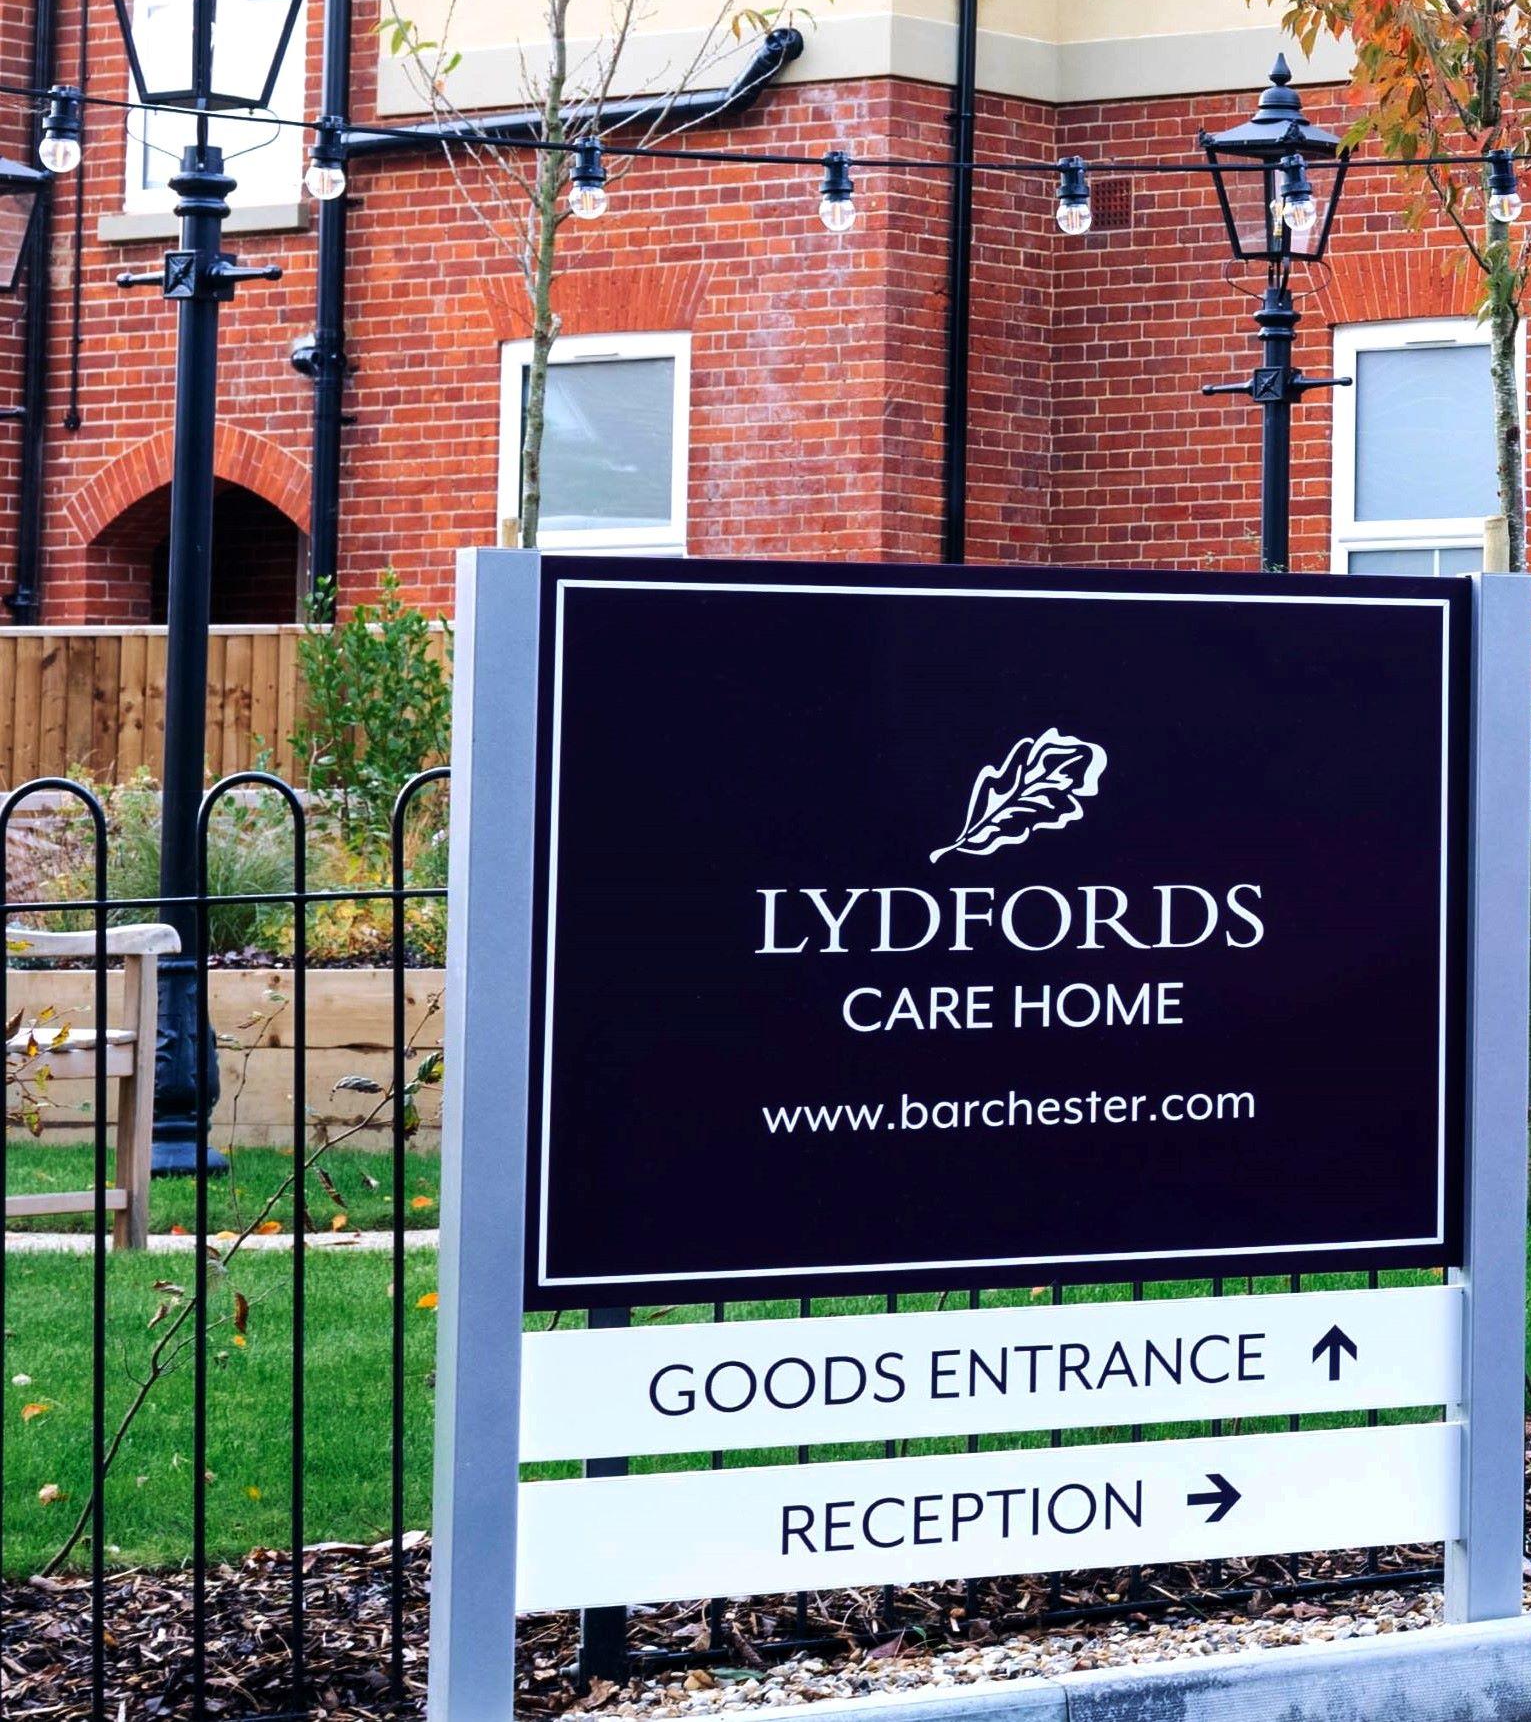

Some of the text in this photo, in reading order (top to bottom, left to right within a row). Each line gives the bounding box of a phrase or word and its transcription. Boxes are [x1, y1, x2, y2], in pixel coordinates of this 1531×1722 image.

[754, 883, 1265, 955] LYDFORDS
[842, 982, 1184, 1033] CARE HOME
[762, 1090, 1256, 1135] www.barchester.com
[648, 1333, 1266, 1418] GOODS ENTRANCE
[781, 1479, 1143, 1557] RECEPTION
